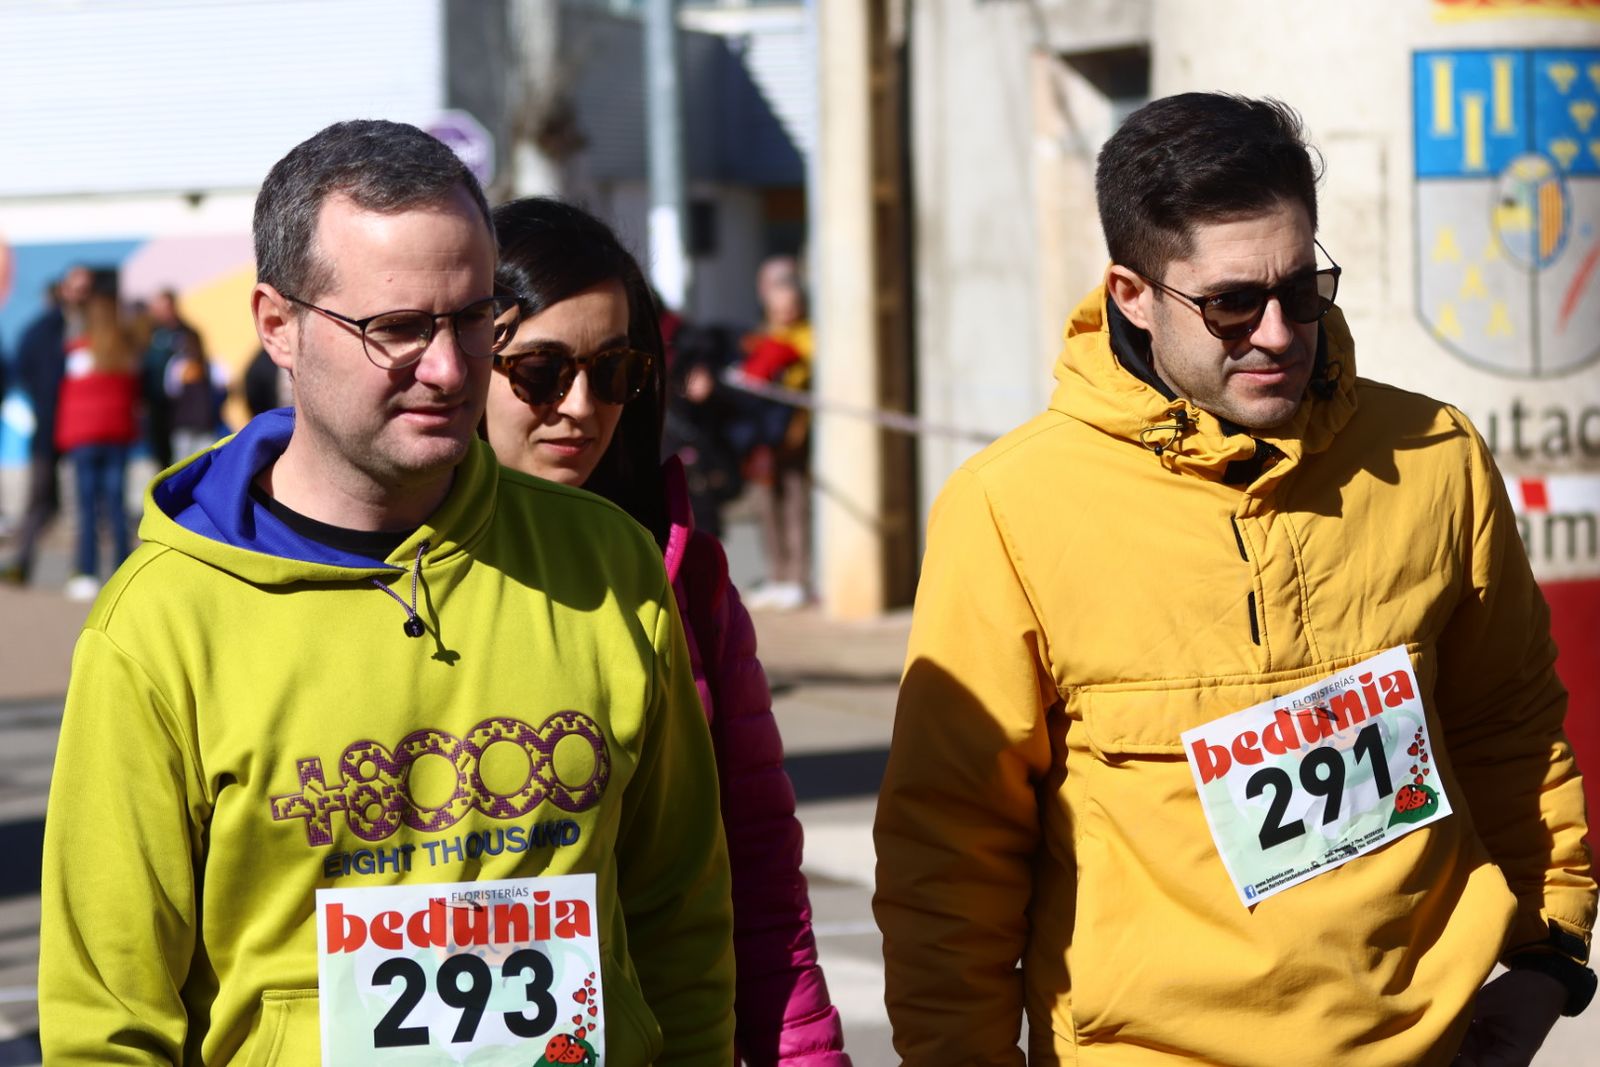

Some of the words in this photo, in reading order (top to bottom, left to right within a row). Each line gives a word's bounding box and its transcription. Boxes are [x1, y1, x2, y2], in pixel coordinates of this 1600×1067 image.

[1292, 674, 1356, 709] FLORISTERÍAS
[1191, 669, 1415, 785] bedunia
[1245, 722, 1394, 851] 291
[323, 844, 417, 878] EIGHT
[422, 819, 581, 867] THOUSAND
[325, 890, 592, 955] bedunia
[451, 887, 530, 902] FLORISTERÍAS
[371, 949, 558, 1049] 293
